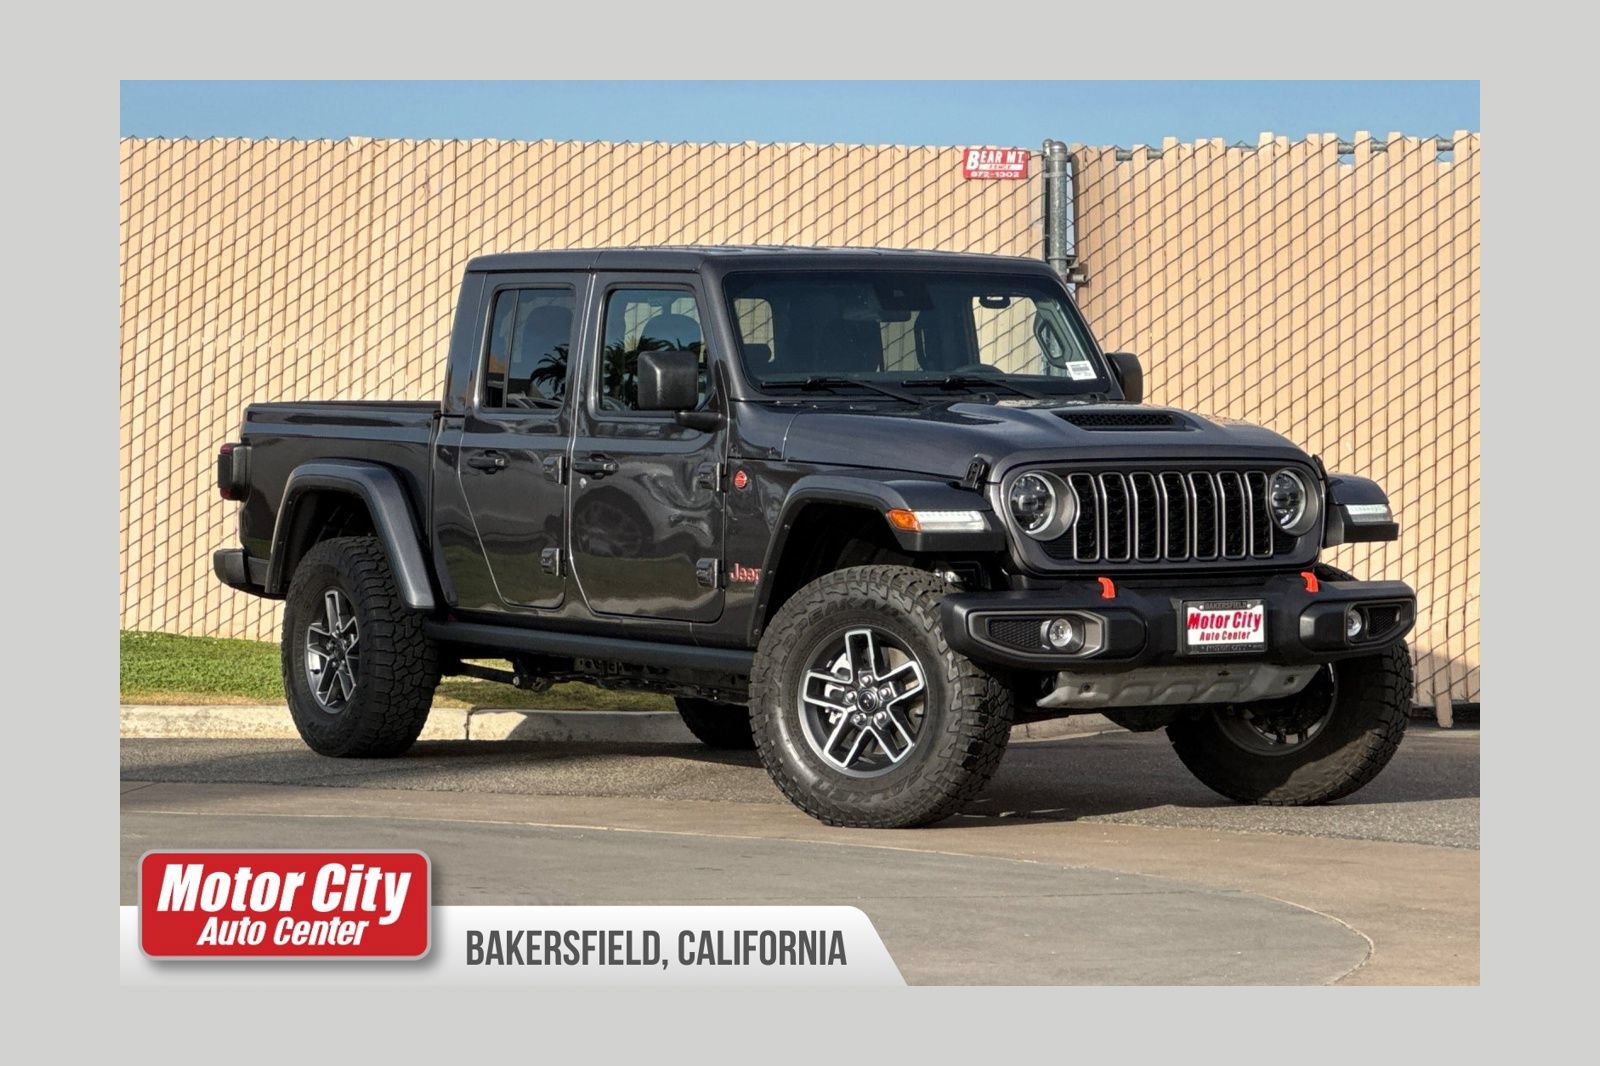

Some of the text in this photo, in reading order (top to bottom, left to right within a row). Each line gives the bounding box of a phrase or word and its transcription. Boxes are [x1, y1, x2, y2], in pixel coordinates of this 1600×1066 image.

[966, 150, 1003, 170] BEAR
[1186, 611, 1262, 632] Motor City
[1200, 631, 1251, 641] Auto Center
